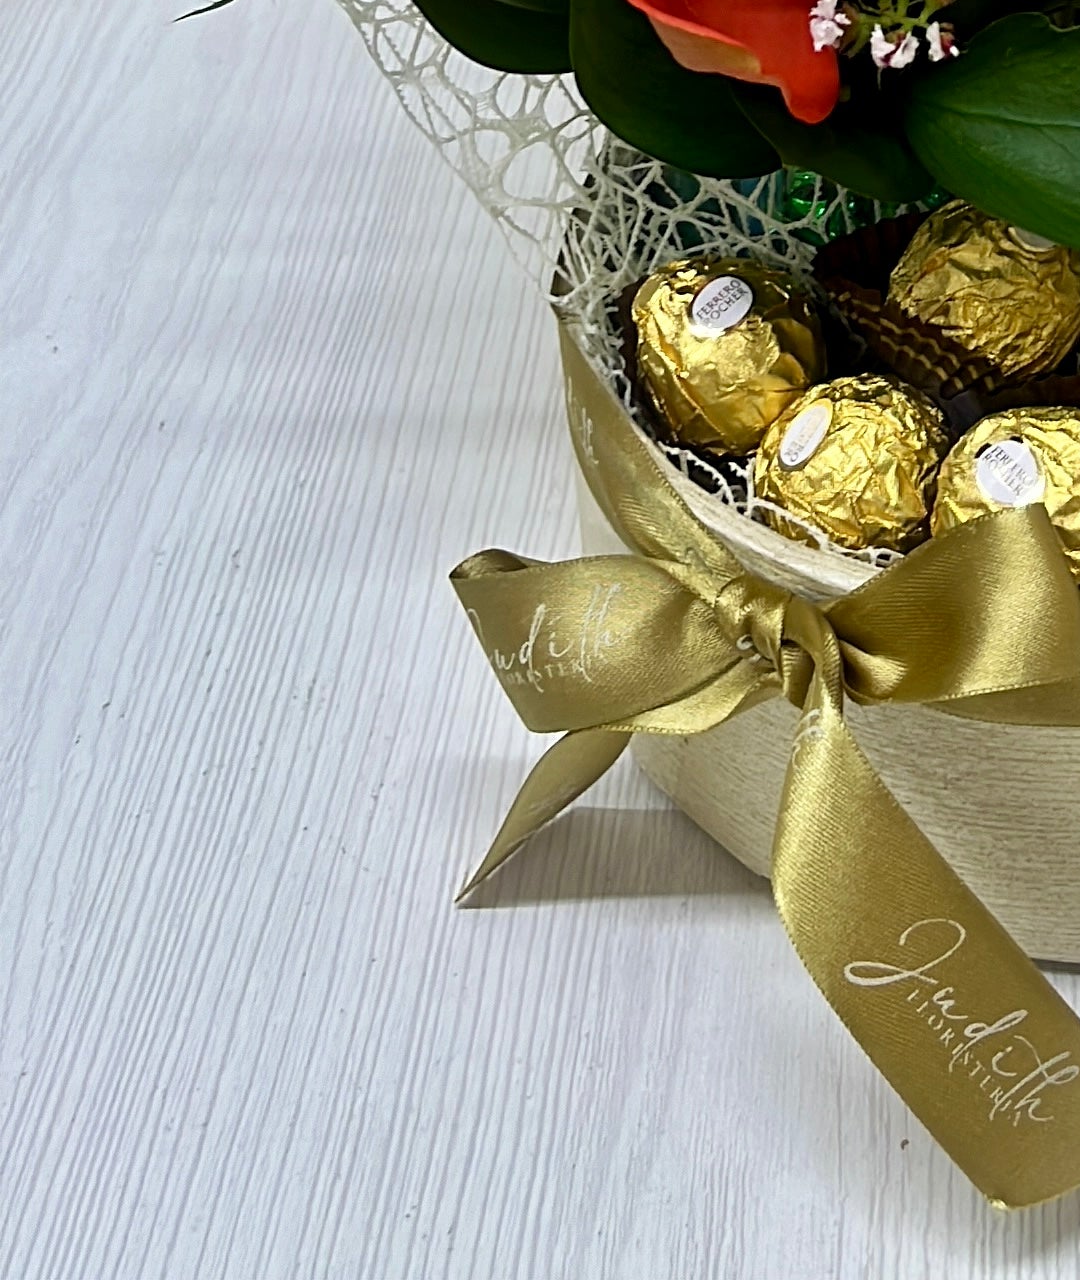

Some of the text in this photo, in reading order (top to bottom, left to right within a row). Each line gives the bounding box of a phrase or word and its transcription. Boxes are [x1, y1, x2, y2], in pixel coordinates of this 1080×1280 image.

[696, 280, 741, 320] FERRERO
[467, 582, 635, 693] udith
[843, 918, 1080, 1122] Judith
